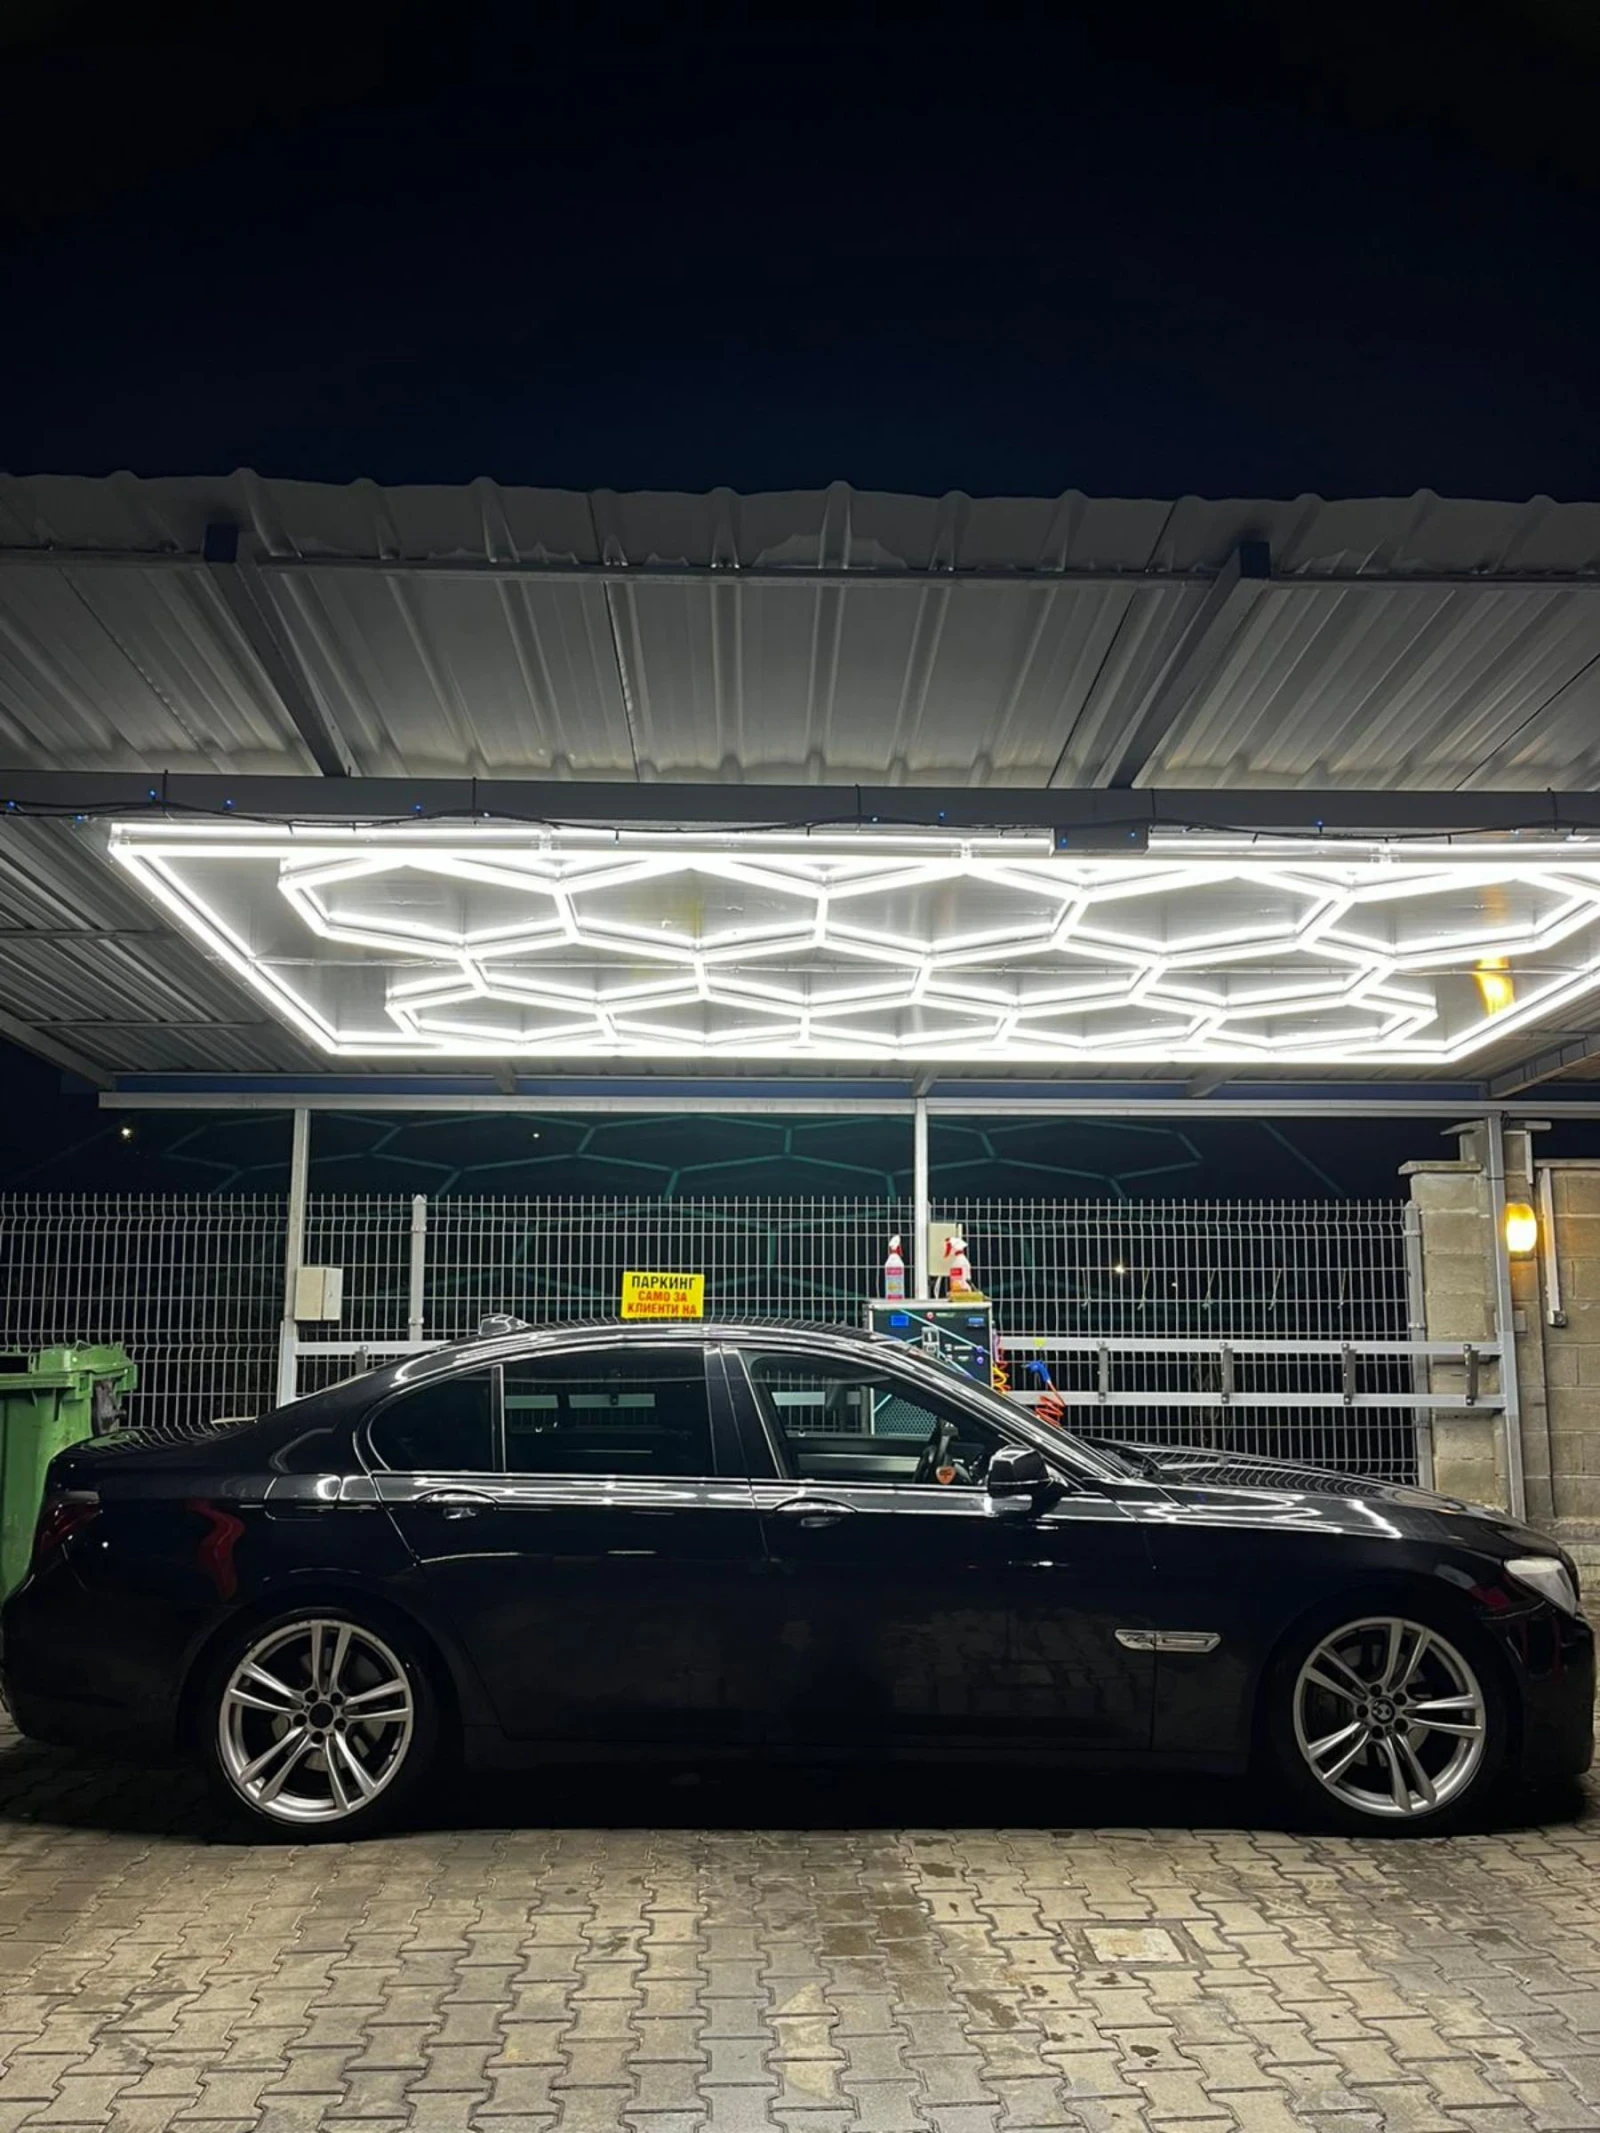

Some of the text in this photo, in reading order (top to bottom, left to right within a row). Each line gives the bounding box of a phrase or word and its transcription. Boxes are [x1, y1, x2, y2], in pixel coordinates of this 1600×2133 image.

[632, 1275, 695, 1290] ПАРКИНГ
[638, 1290, 687, 1302] САМО ЗА
[627, 1303, 696, 1315] КЛИЕНТИ НА
